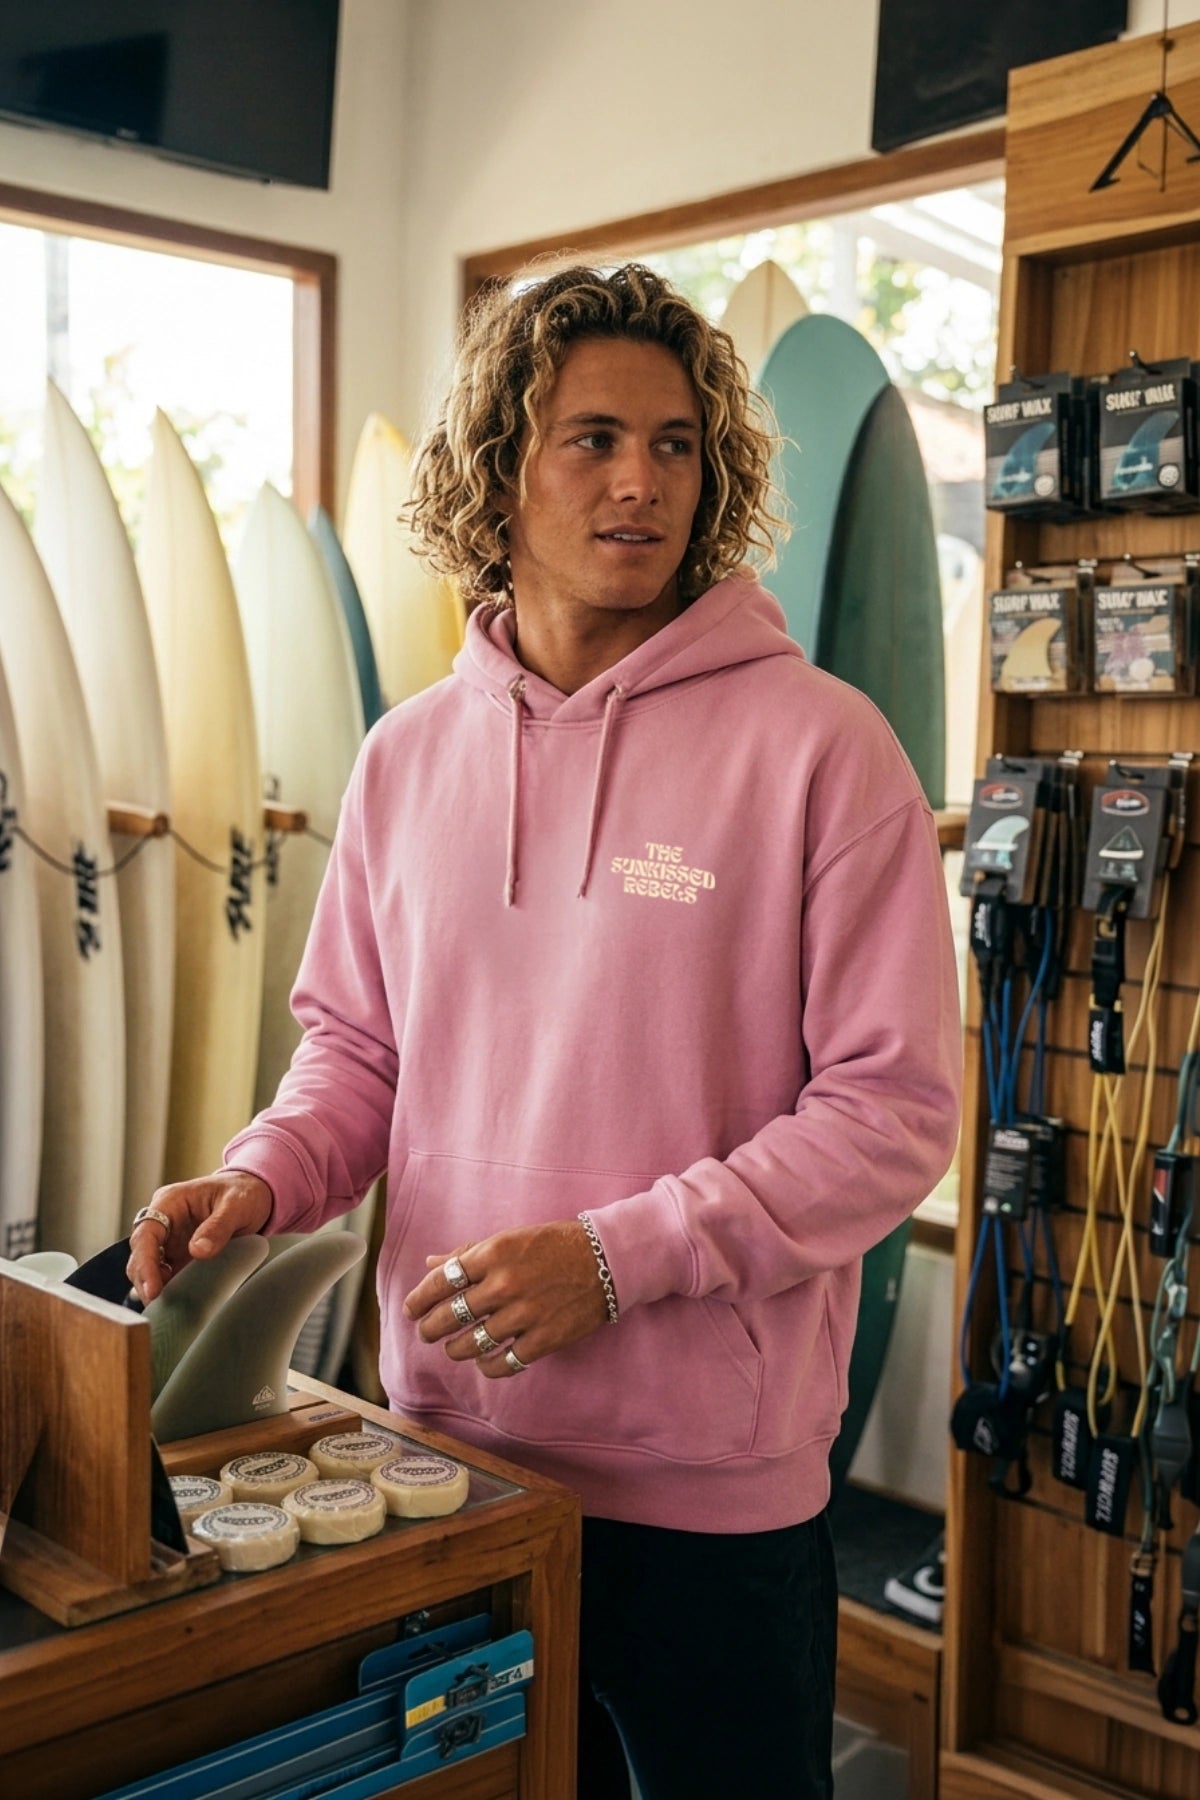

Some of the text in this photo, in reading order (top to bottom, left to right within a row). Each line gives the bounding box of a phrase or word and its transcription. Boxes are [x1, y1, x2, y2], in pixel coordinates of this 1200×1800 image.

[645, 842, 684, 863] THE
[610, 856, 716, 890] SUNKISSED
[623, 876, 698, 905] REBELS
